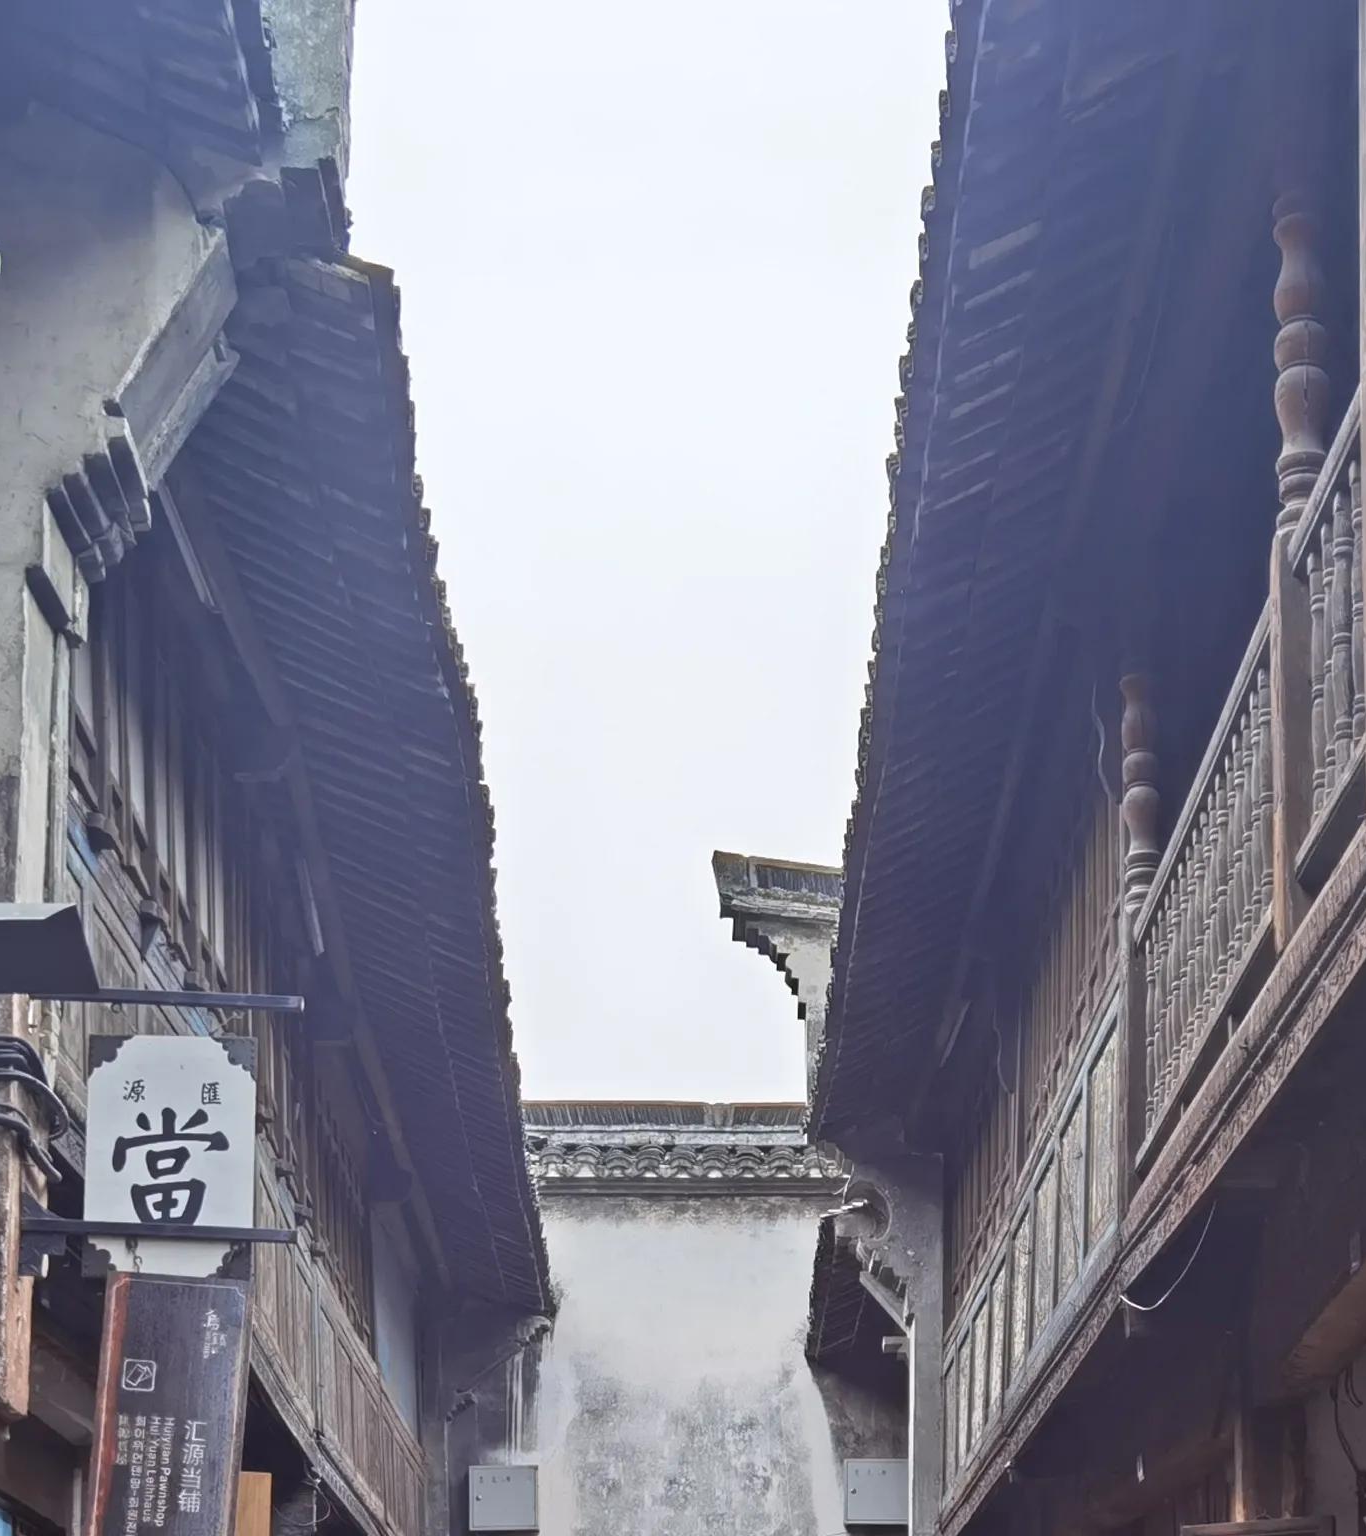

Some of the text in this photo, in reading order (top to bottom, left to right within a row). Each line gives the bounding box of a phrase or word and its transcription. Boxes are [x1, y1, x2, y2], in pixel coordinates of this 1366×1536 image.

[112, 1107, 230, 1225] 當
[154, 1467, 172, 1527] Pawnshop
[178, 1420, 207, 1512] 汇源当铺
